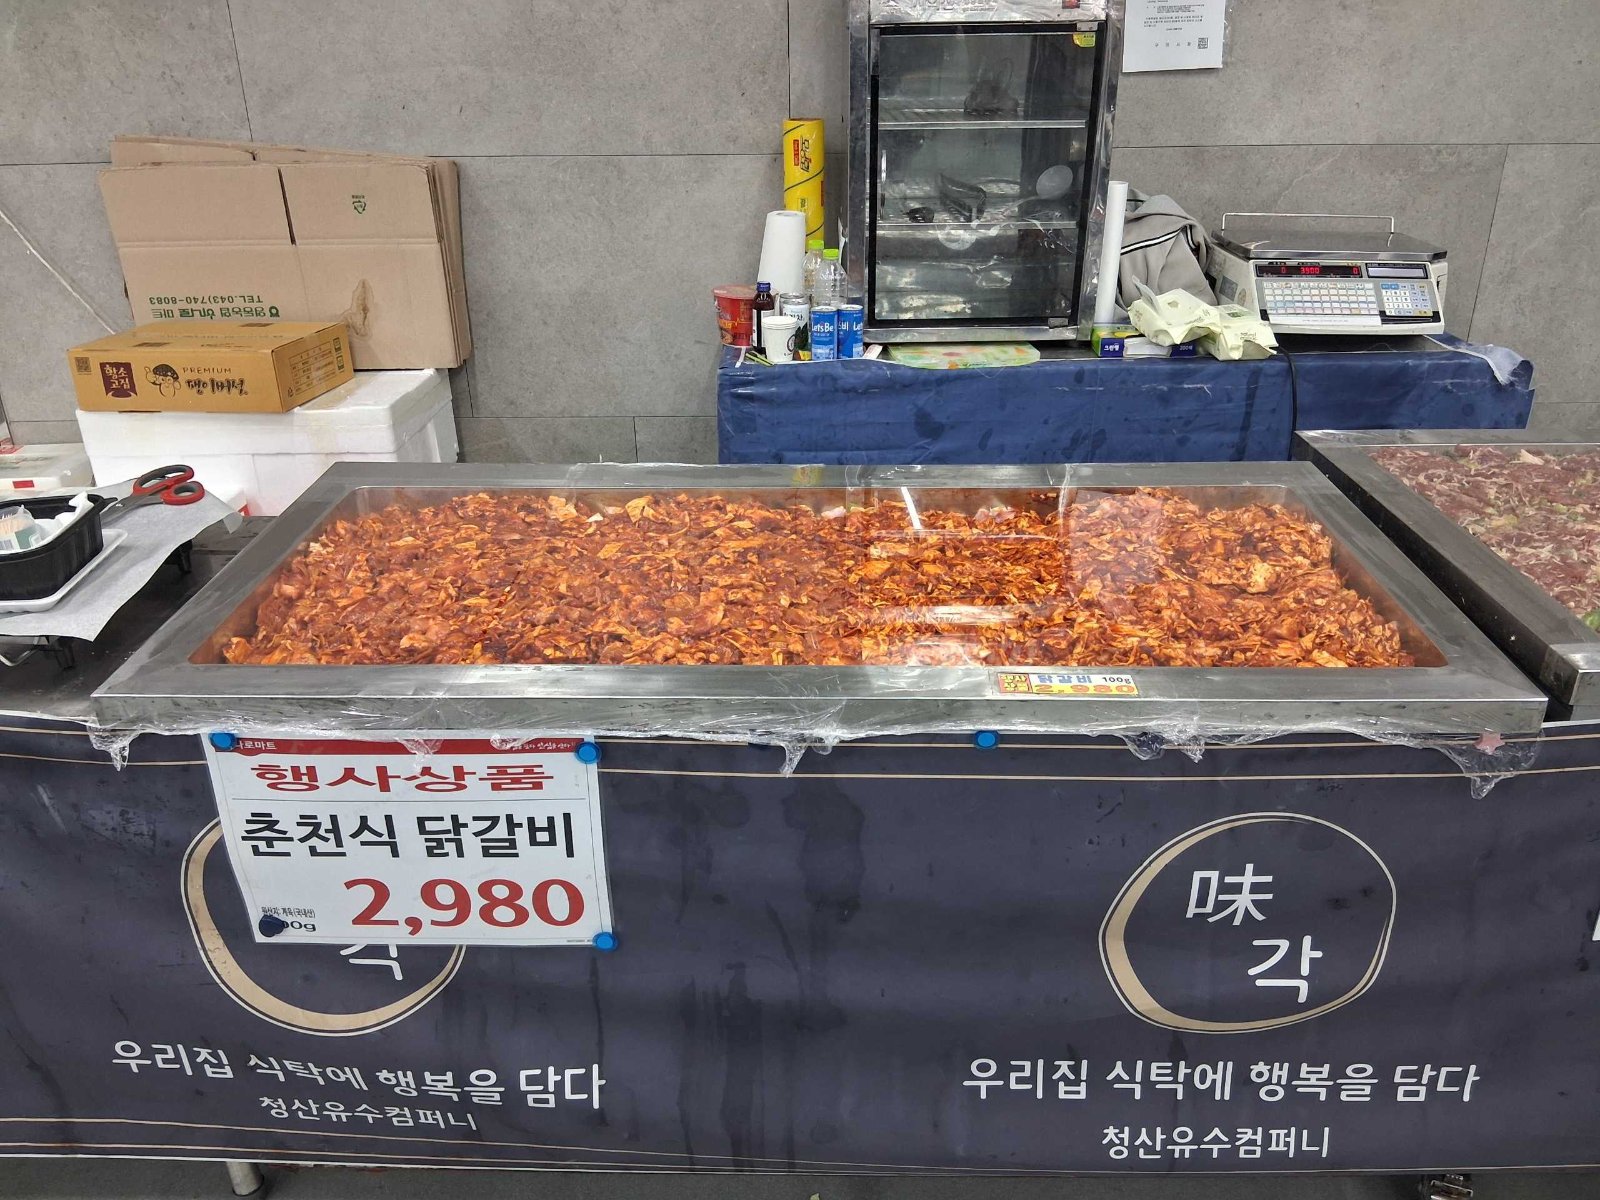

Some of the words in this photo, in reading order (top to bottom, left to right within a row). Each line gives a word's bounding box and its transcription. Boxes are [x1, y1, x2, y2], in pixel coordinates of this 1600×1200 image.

[149, 295, 263, 305] TEL.043)740-8083
[219, 306, 266, 318] 영동농협
[104, 364, 128, 379] 황소
[110, 377, 130, 389] 고집
[1102, 676, 1132, 684] 100g
[239, 740, 277, 750] 로마트
[249, 763, 555, 793] 행사상품
[240, 811, 401, 857] 춘천식
[415, 811, 575, 859] 닭갈비
[343, 877, 586, 937] 2,980
[1185, 863, 1274, 927] 味
[1247, 935, 1324, 1004] 각
[112, 1040, 234, 1080] 우리집
[246, 1052, 369, 1092] 식탁에
[375, 1065, 505, 1104] 행복을
[518, 1063, 607, 1110] 담다
[962, 1058, 1088, 1100] 우리집
[1106, 1059, 1234, 1101] 식탁에
[1249, 1061, 1379, 1102] 행복을
[1393, 1063, 1481, 1103] 담다
[260, 1095, 478, 1131] 청산유수컴퍼니
[1101, 1125, 1330, 1160] 청산유수컴퍼니
